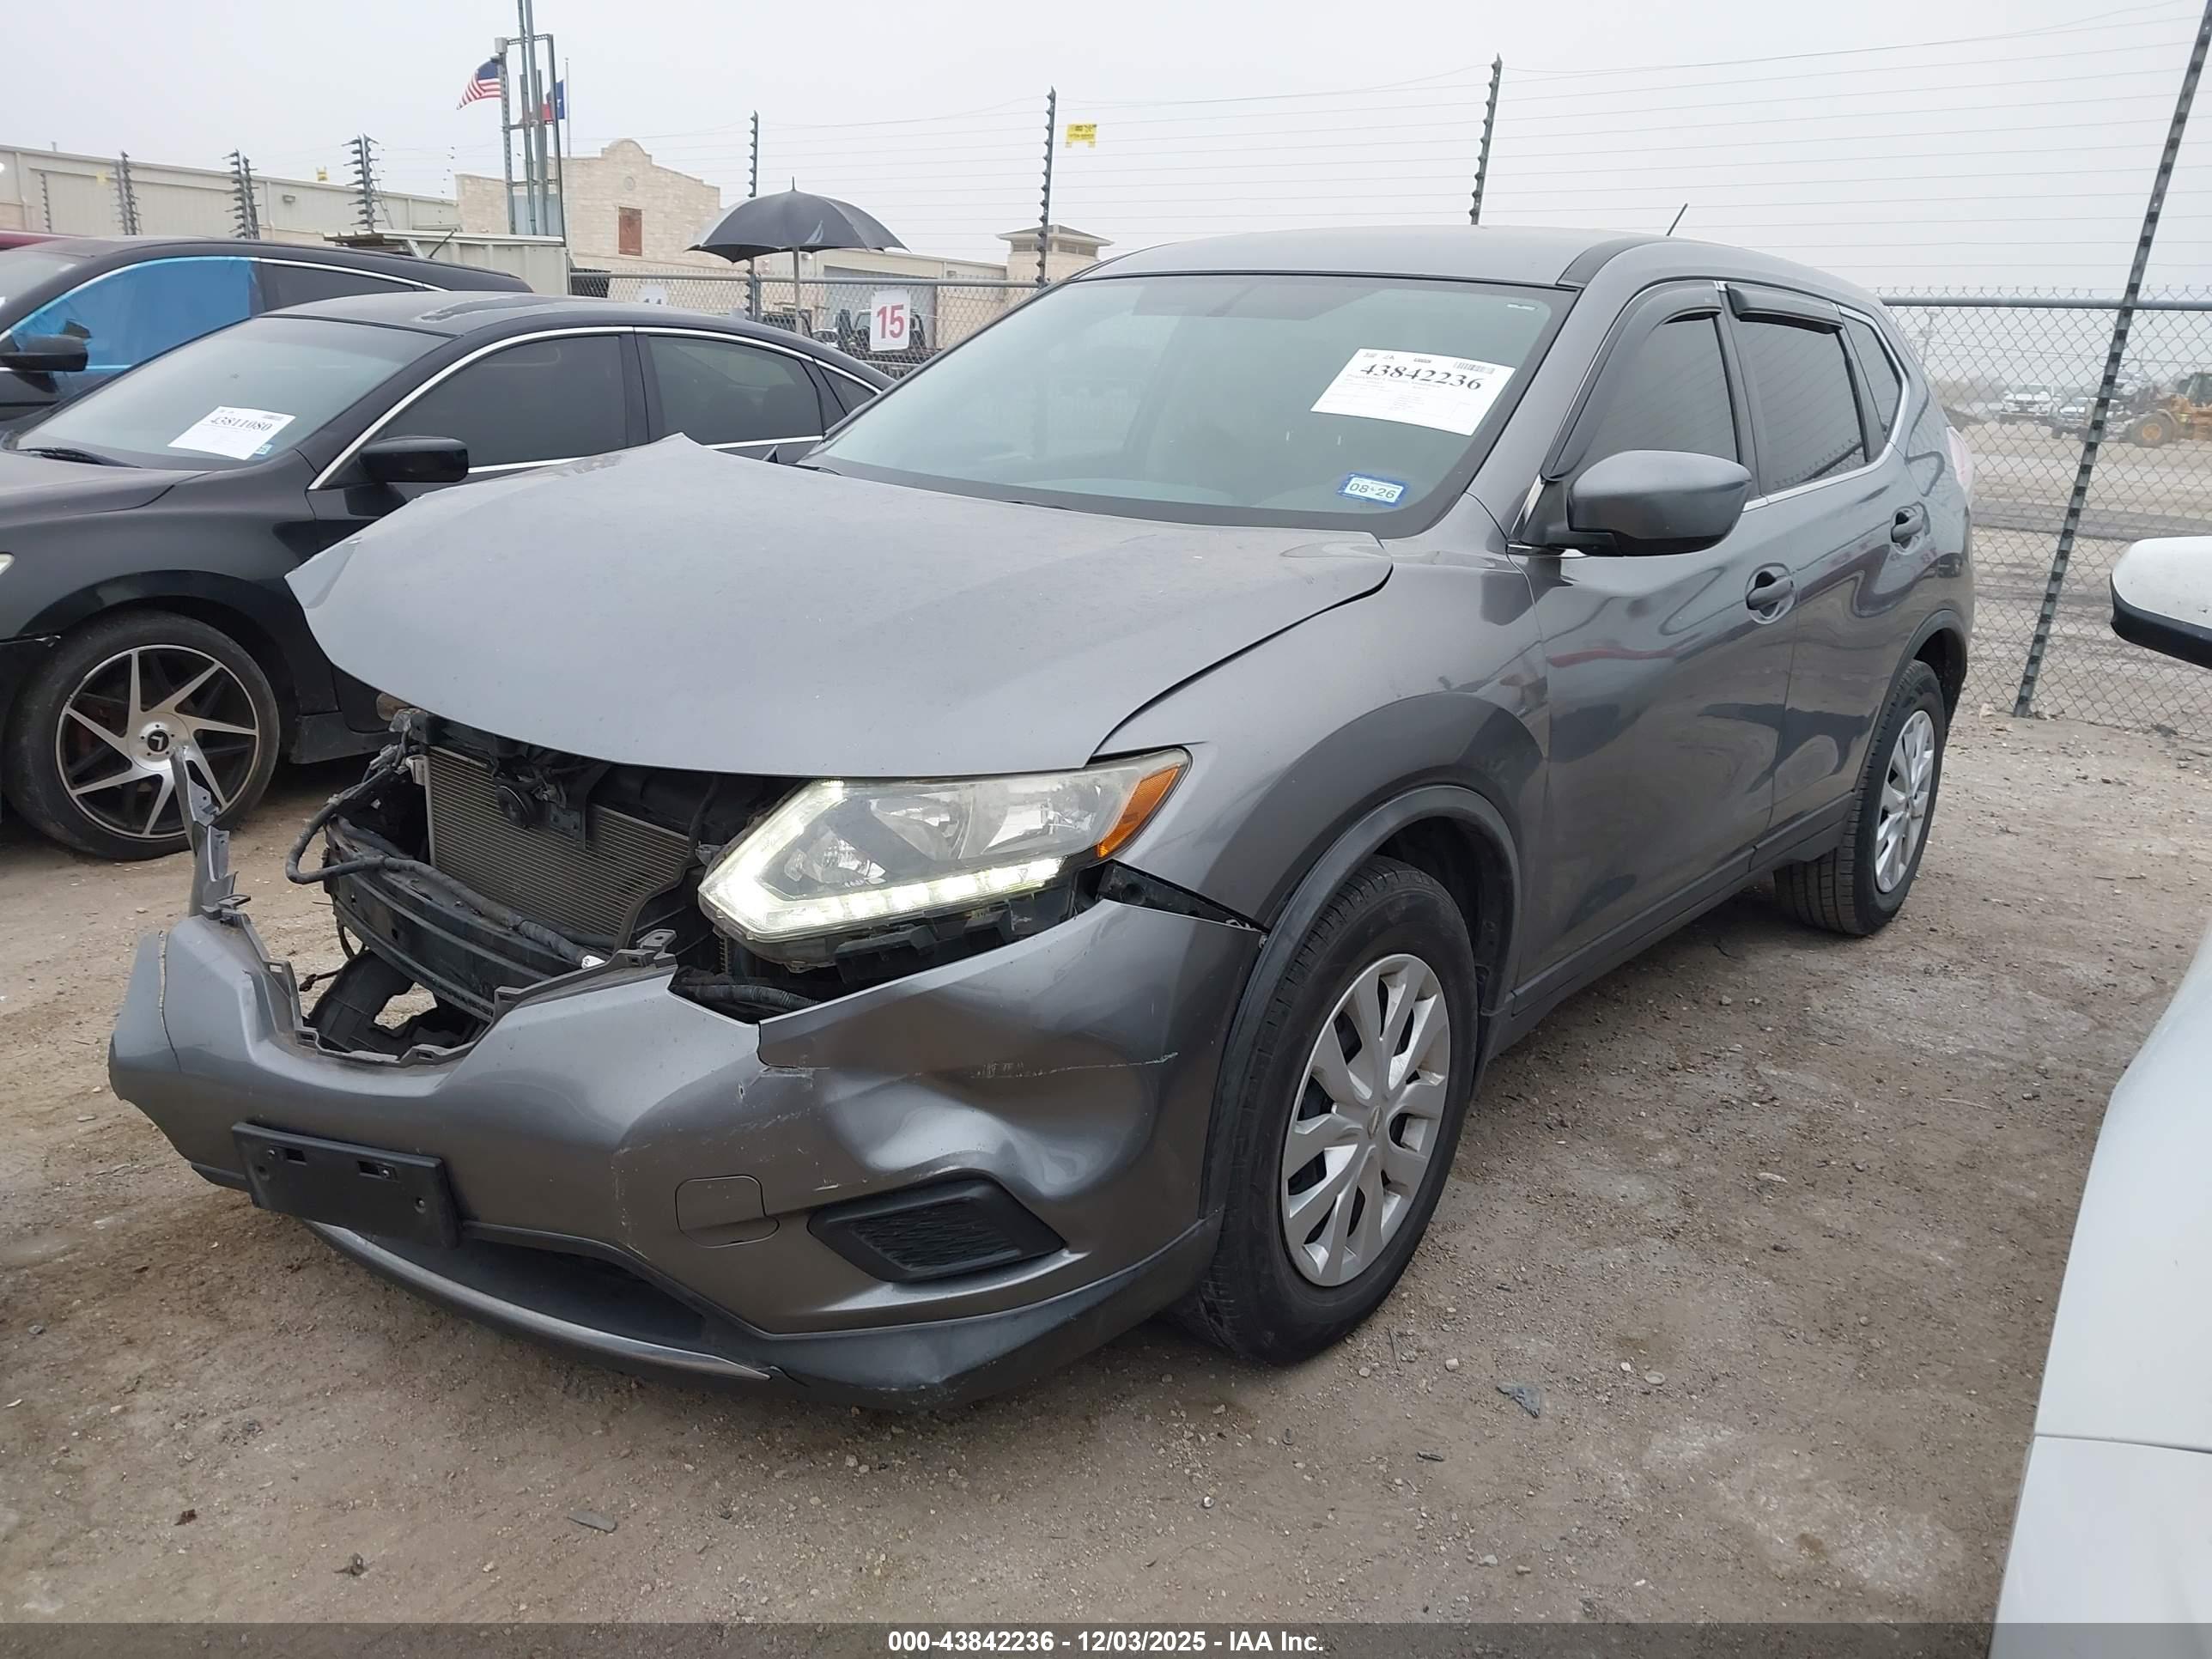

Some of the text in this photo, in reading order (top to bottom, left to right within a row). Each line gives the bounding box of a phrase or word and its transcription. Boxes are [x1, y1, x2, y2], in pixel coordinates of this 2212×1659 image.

[876, 304, 905, 339] 15
[1360, 363, 1485, 391] 43842236
[1349, 483, 1370, 494] 08
[1375, 488, 1397, 499] 26
